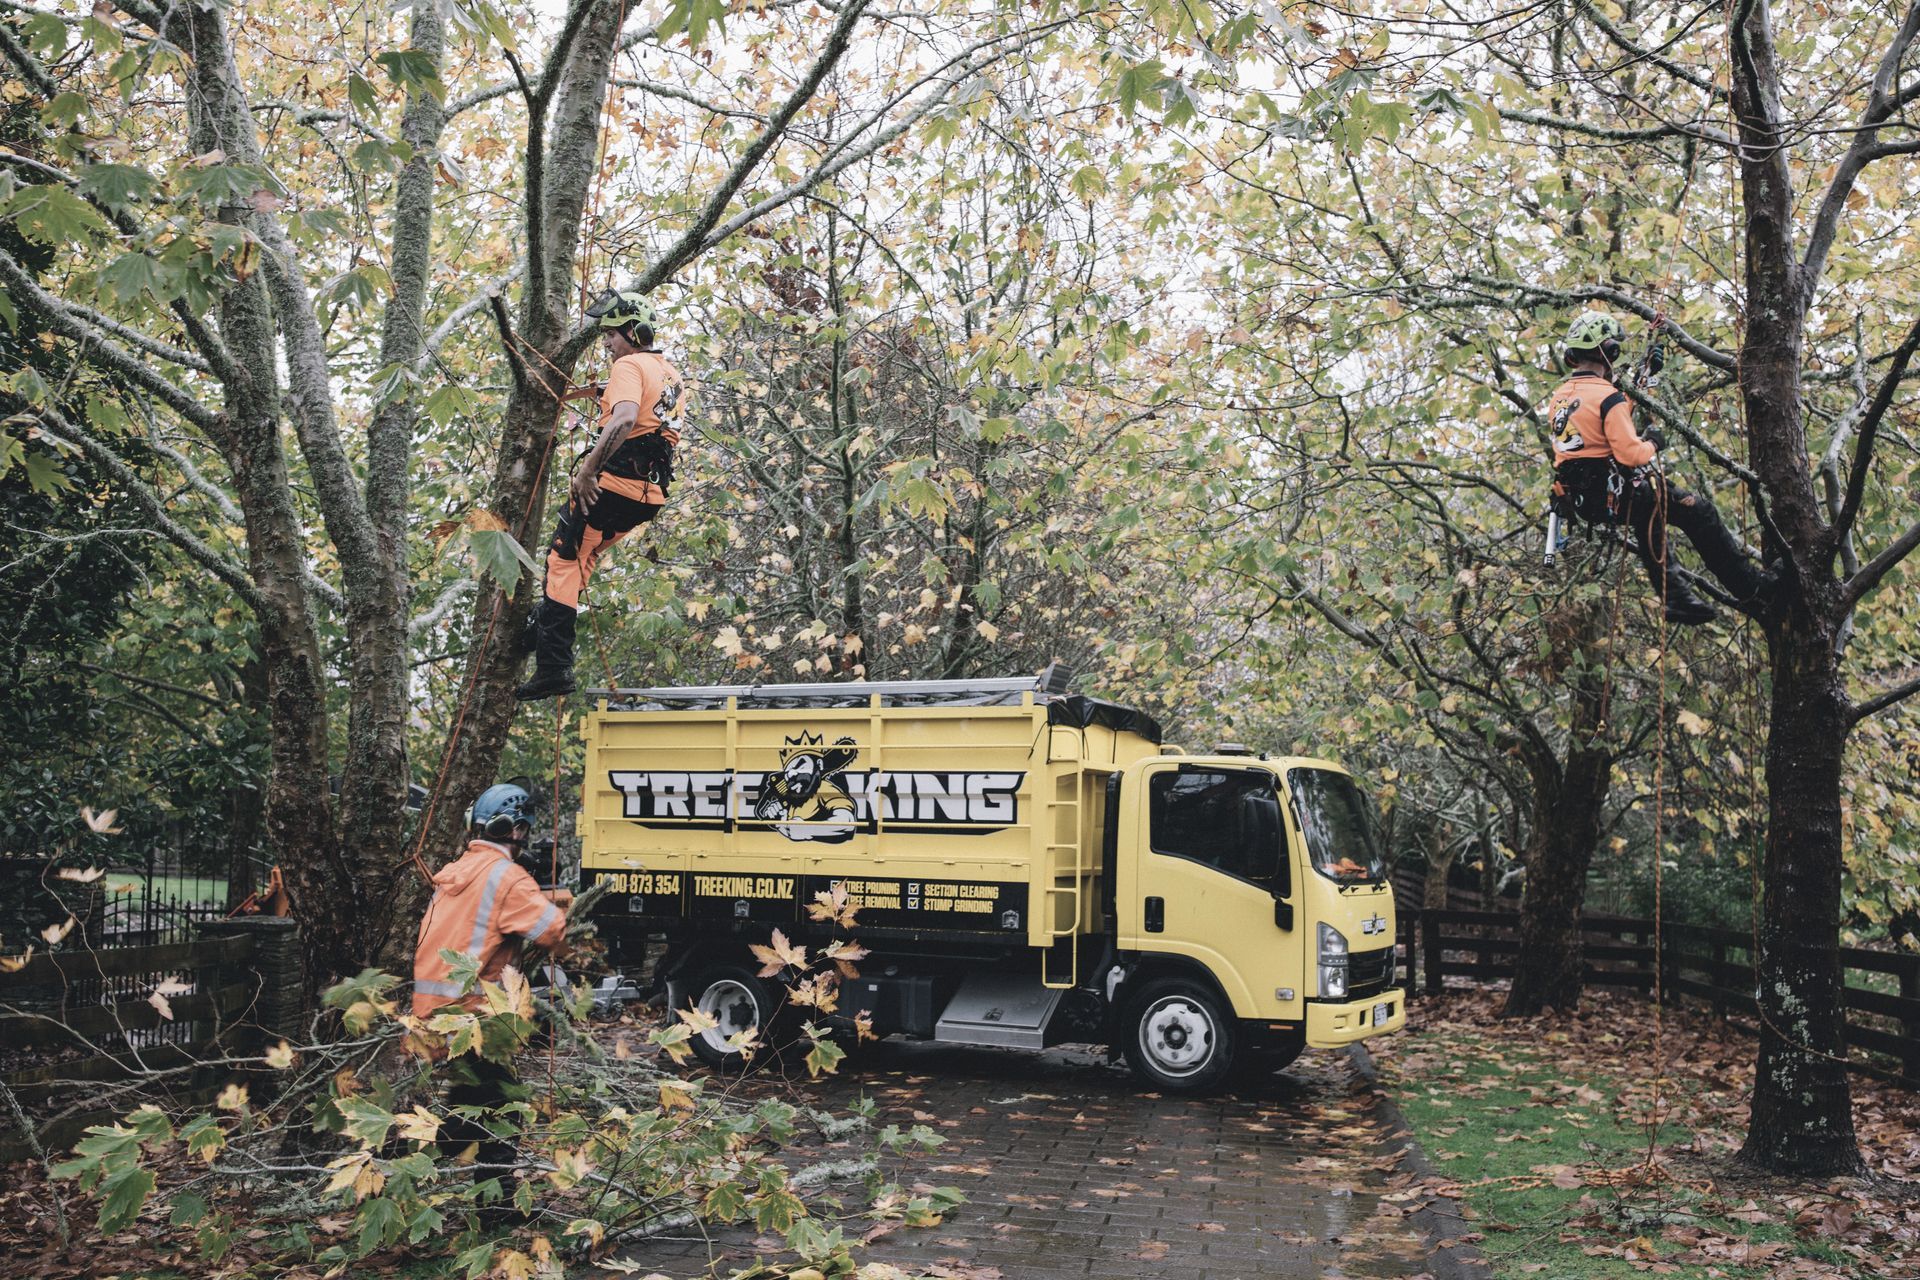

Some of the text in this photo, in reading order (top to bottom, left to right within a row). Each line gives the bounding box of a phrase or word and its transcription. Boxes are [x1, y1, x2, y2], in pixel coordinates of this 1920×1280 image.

[611, 772, 1021, 822] TREE KING
[630, 873, 654, 895] 873
[655, 874, 681, 896] 354
[694, 876, 795, 900] TREEKING.CO.NZ
[846, 880, 901, 895] TREE PRUNING
[924, 883, 999, 900] SECTION CLEARING
[865, 895, 902, 910] REMOVAL
[923, 898, 994, 914] STUMP GRINDING
